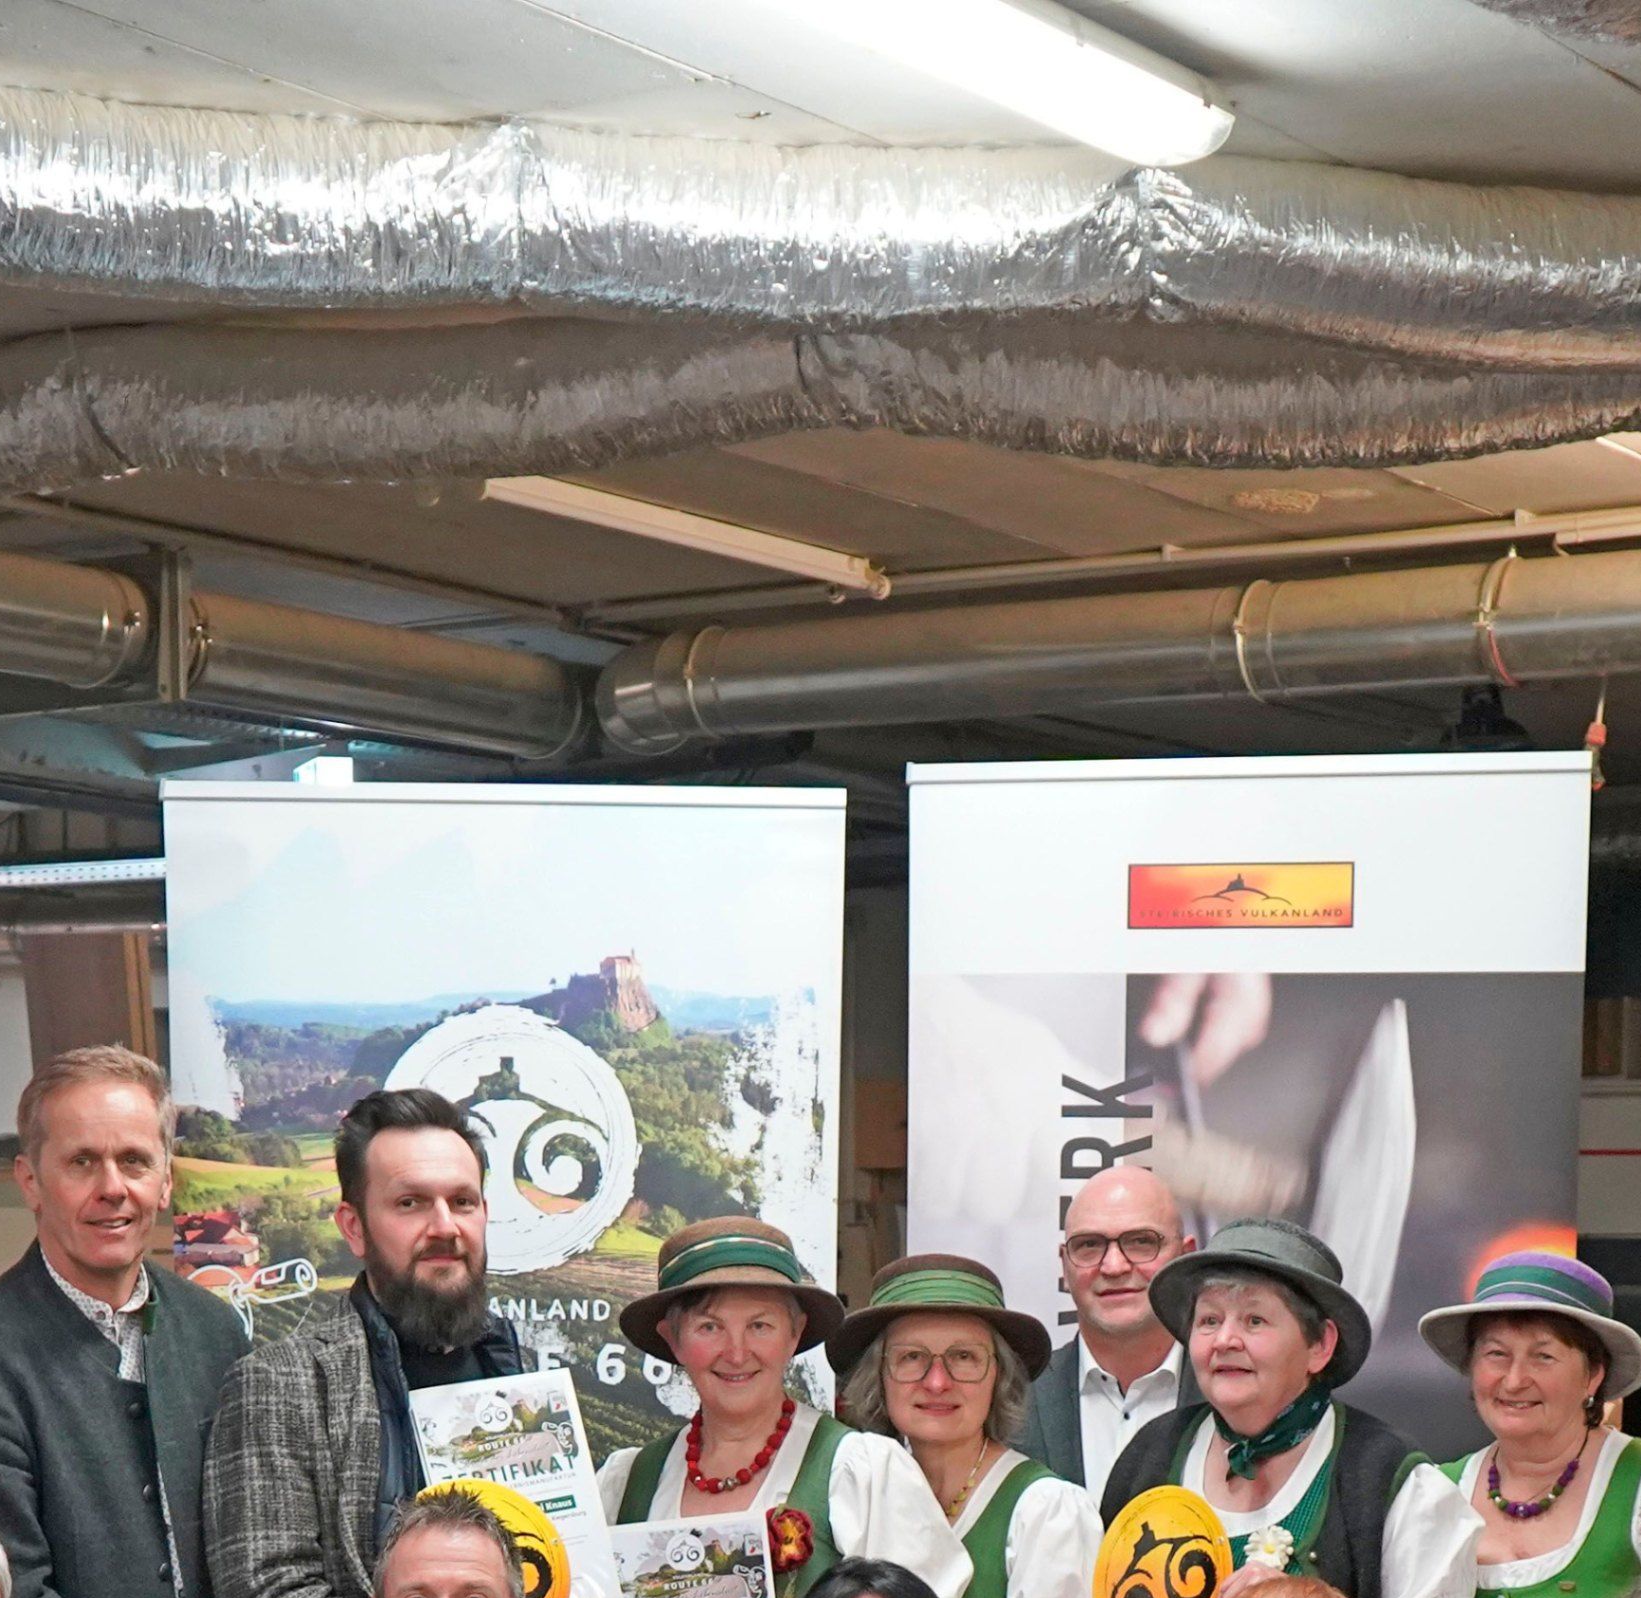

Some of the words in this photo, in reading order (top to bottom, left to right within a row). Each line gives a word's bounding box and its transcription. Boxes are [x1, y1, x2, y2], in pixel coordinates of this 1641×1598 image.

[1239, 907, 1344, 919] VULKANLAND
[488, 1296, 611, 1322] ANLAND
[545, 1499, 573, 1511] Knaus
[663, 1578, 698, 1590] ROUTE
